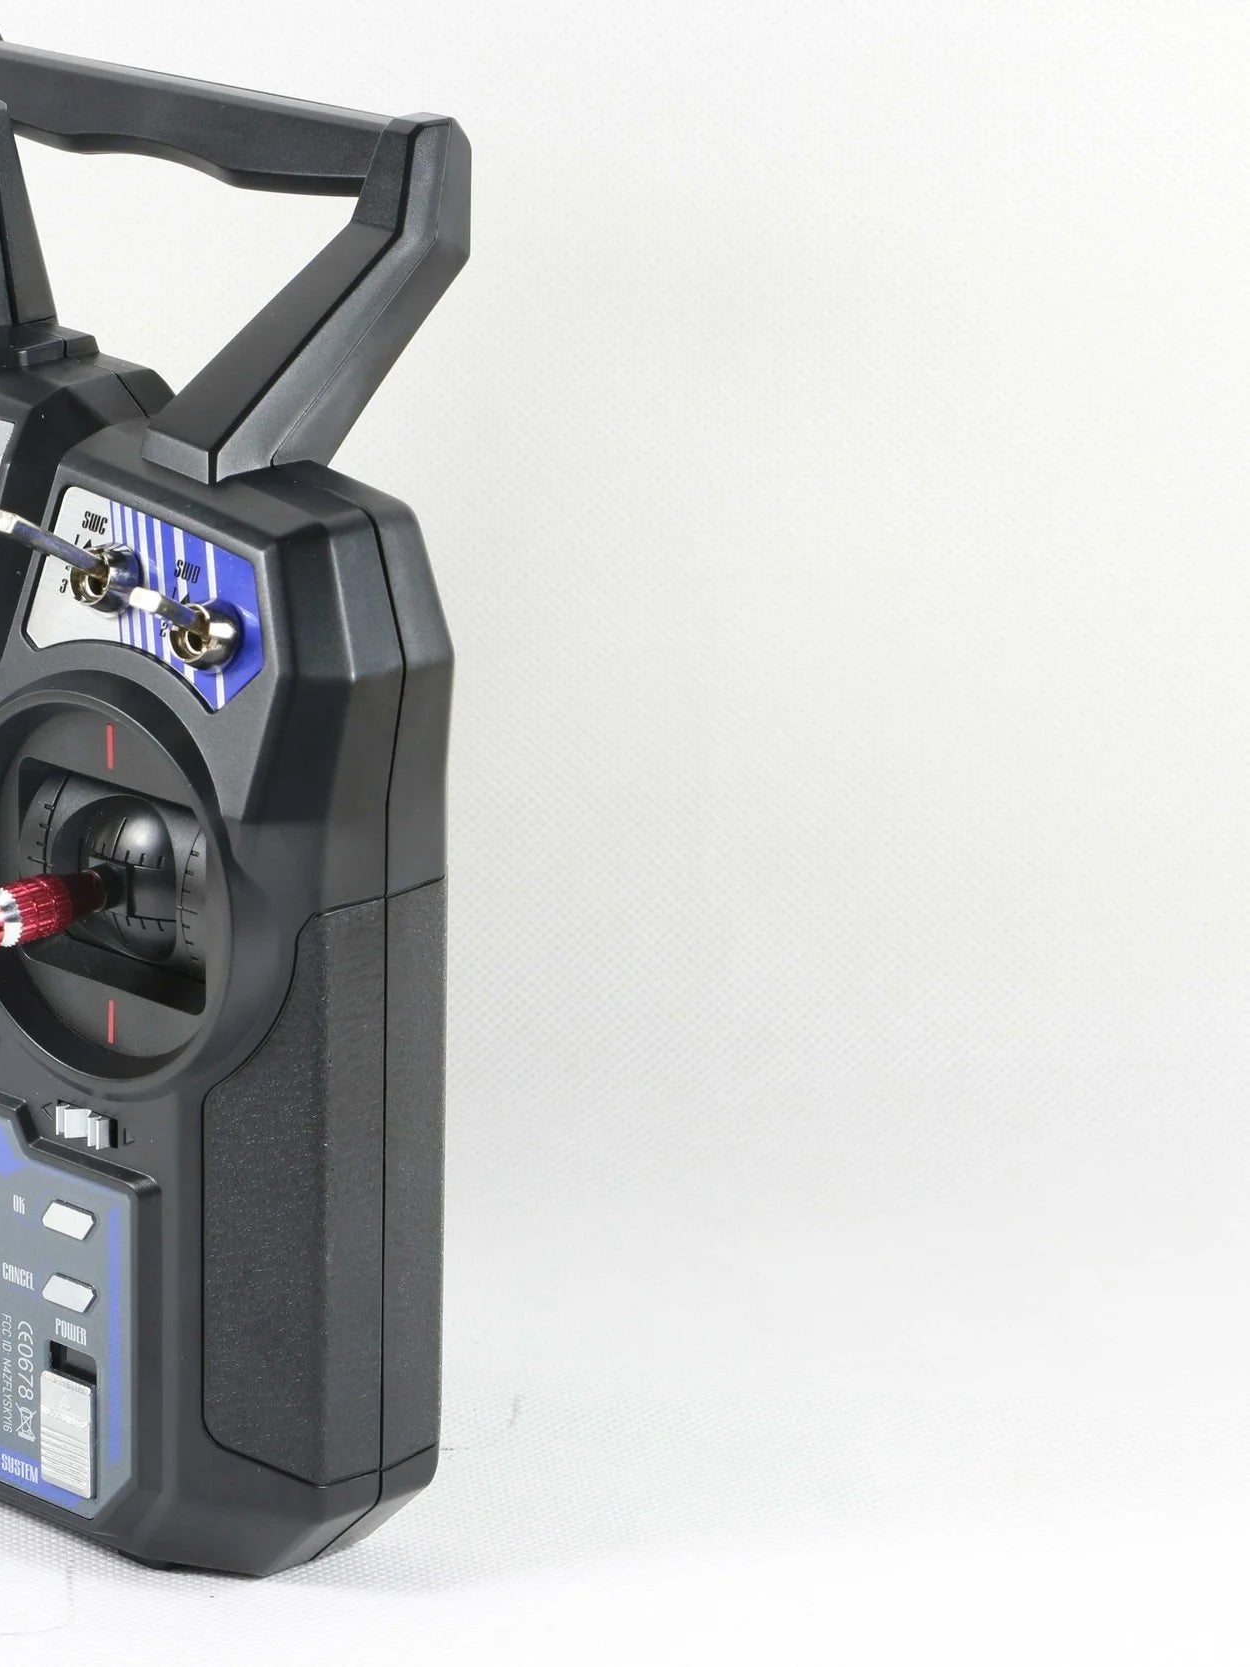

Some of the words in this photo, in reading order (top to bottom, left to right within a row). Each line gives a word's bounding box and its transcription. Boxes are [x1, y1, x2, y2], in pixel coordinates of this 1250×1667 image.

[81, 510, 109, 535] SWC
[173, 559, 201, 584] SWD
[59, 578, 68, 594] 3
[12, 1194, 26, 1215] OK
[2, 1262, 35, 1291] CANCEL
[2, 1312, 12, 1338] FCC
[55, 1317, 87, 1346] POWER
[1, 1453, 39, 1484] SYSTEM
